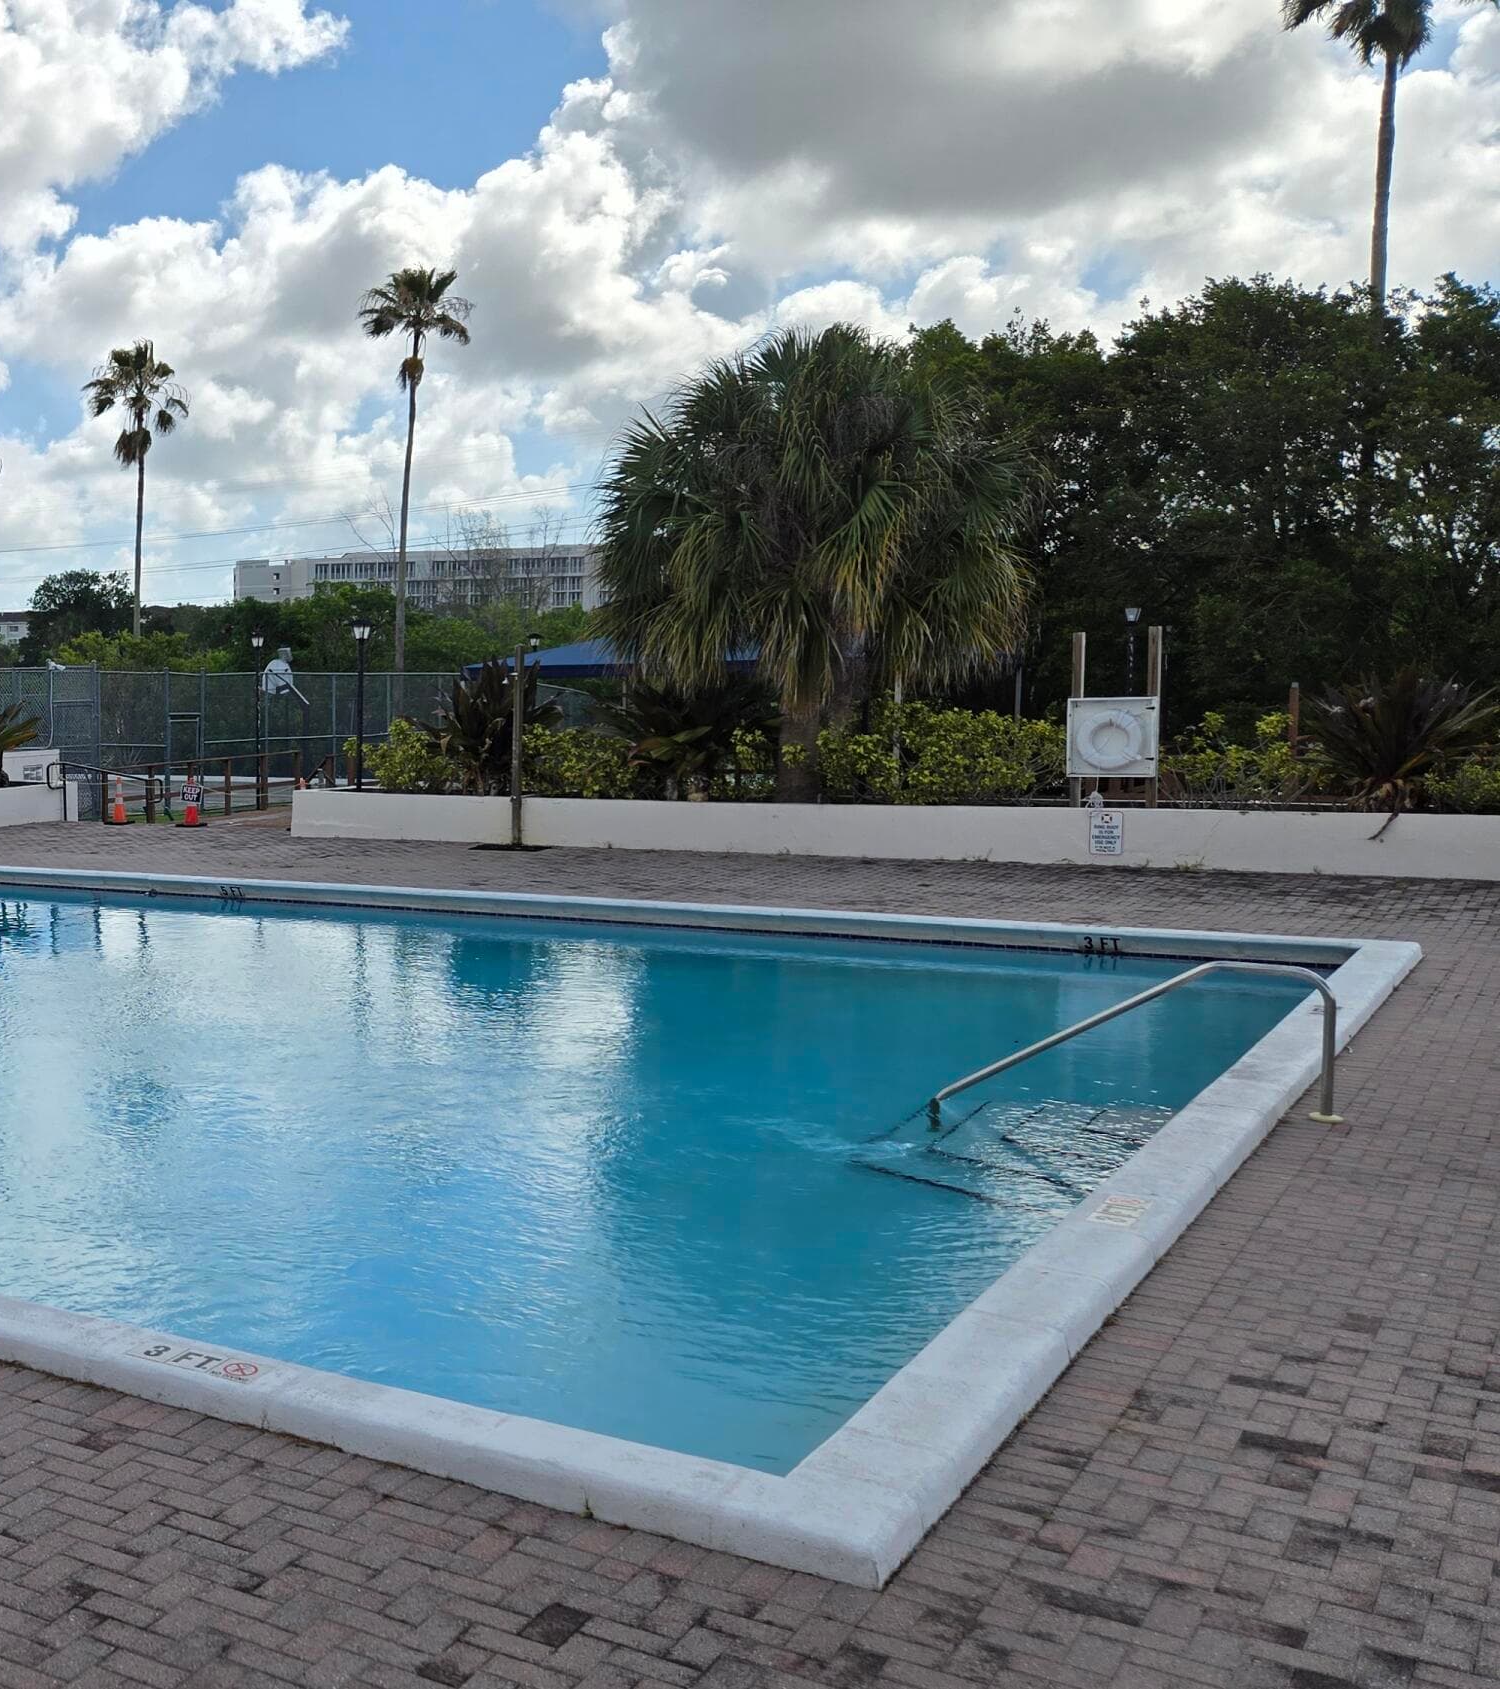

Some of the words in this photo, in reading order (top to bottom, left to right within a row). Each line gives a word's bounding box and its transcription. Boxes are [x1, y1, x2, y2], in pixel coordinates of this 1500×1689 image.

[220, 885, 228, 896] 5
[229, 886, 242, 897] FT
[1083, 935, 1093, 950] 3
[1099, 937, 1121, 951] FT
[143, 1345, 171, 1357] 3
